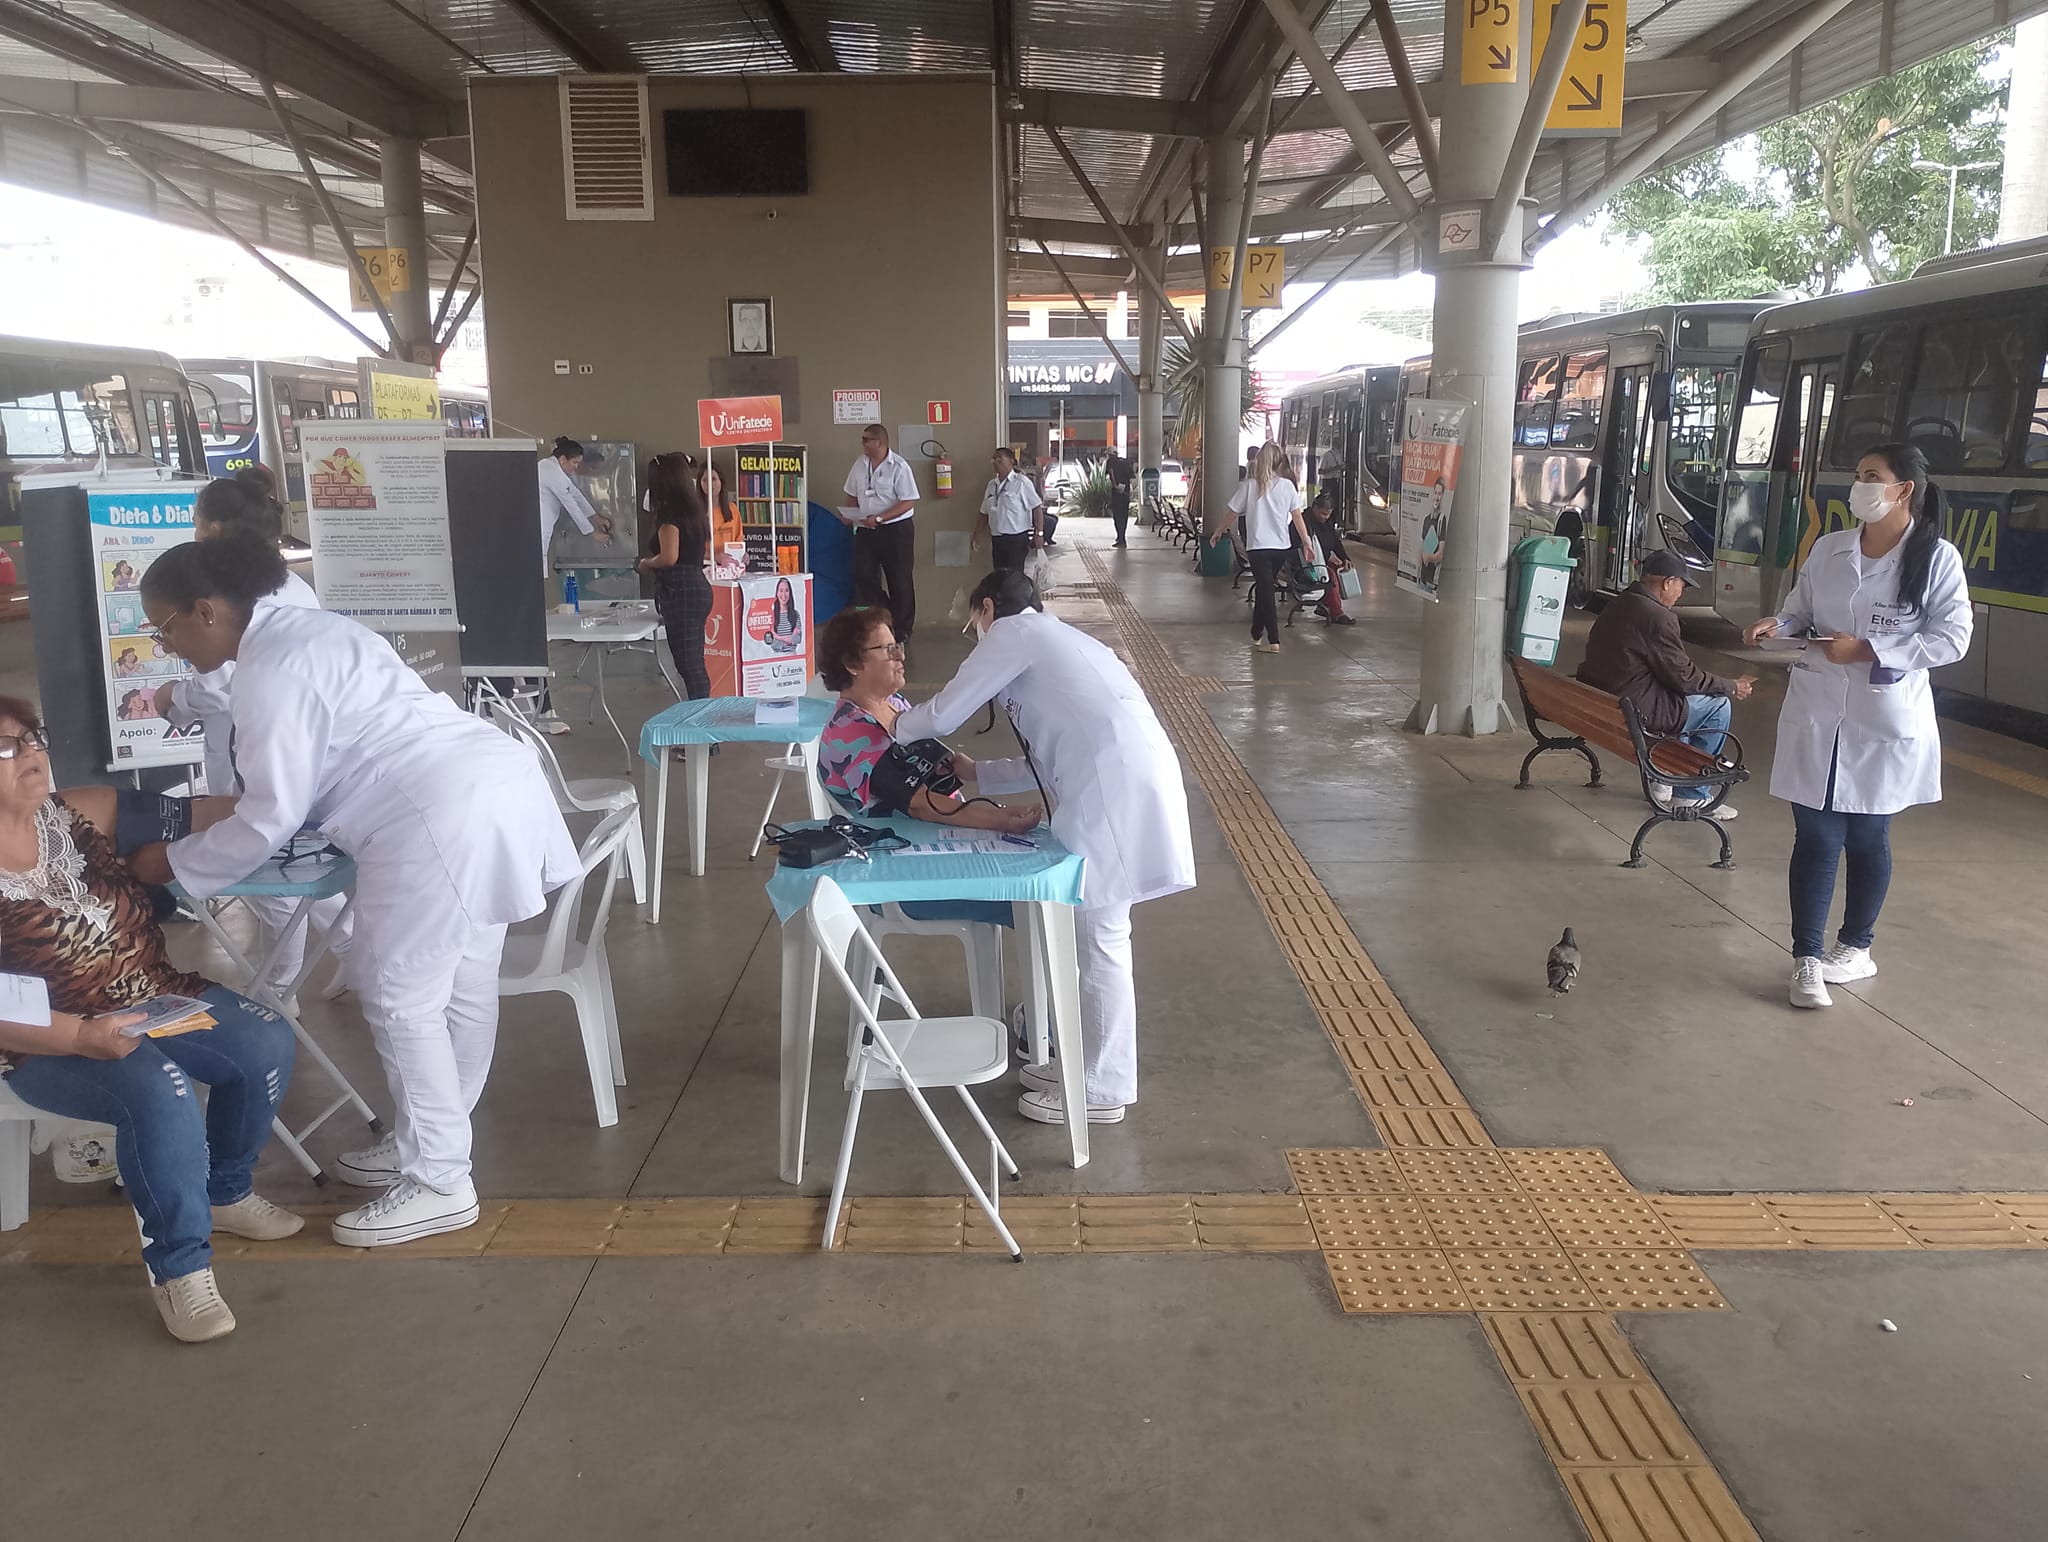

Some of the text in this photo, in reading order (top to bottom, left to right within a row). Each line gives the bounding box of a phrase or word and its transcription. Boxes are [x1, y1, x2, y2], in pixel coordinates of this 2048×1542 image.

[1470, 0, 1510, 28] P5
[390, 254, 405, 268] P6
[1213, 252, 1231, 267] P7
[1250, 253, 1277, 273] P7
[1007, 365, 1060, 383] INTAS
[375, 382, 420, 401] PLATAFORMAS
[837, 391, 876, 400] PROIBIDO
[740, 457, 802, 472] GELADOTECA
[109, 506, 149, 525] Dieta
[1871, 614, 1900, 626] Etec
[397, 633, 407, 651] P5
[119, 728, 157, 738] Apoio:
